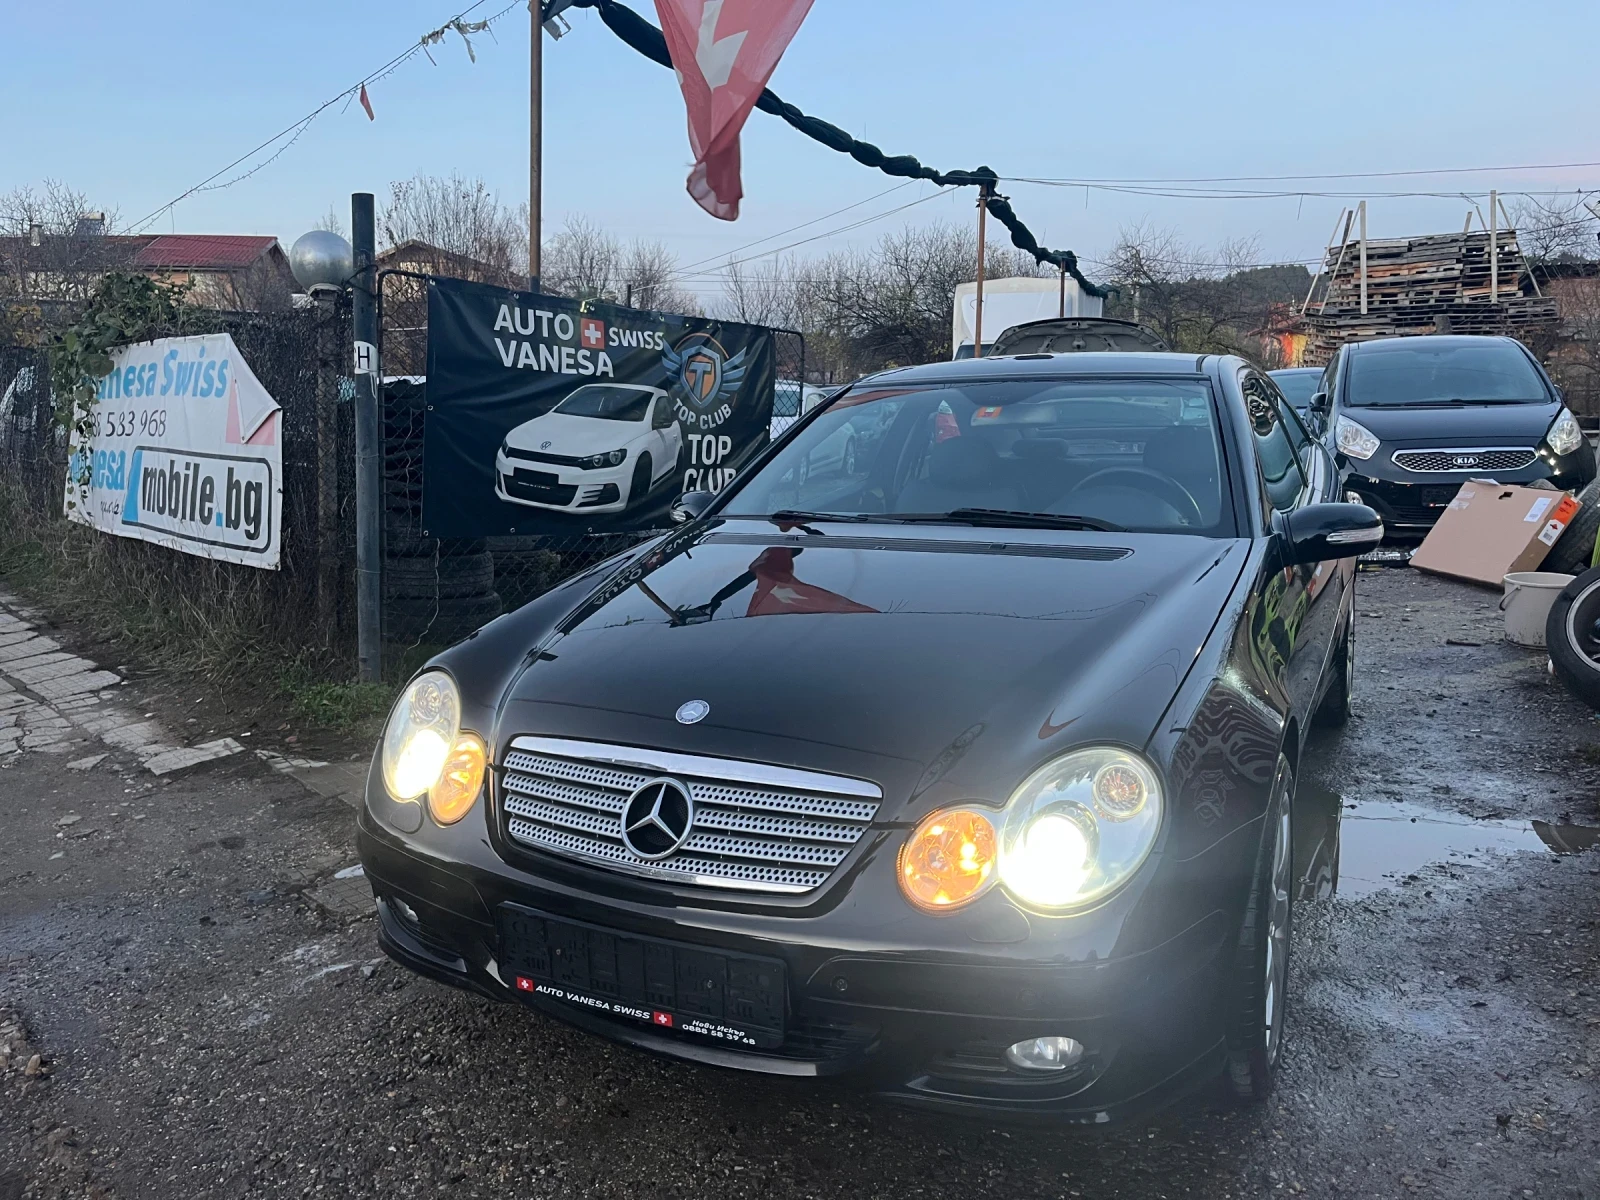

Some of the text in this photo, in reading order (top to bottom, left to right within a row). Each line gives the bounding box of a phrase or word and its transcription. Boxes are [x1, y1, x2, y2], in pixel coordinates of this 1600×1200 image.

[494, 304, 664, 350] AUTO SWISS
[159, 346, 229, 398] Swiss
[358, 346, 370, 369] H
[494, 338, 614, 378] VANESA
[105, 410, 136, 437] 583
[139, 409, 167, 438] 968
[673, 397, 732, 430] TOP CLUB
[687, 433, 732, 466] TOP
[142, 460, 263, 541] mobile.bg
[535, 984, 651, 1020] AUTO VANESA SWISS
[682, 1024, 708, 1034] 0888
[710, 1030, 724, 1038] 58
